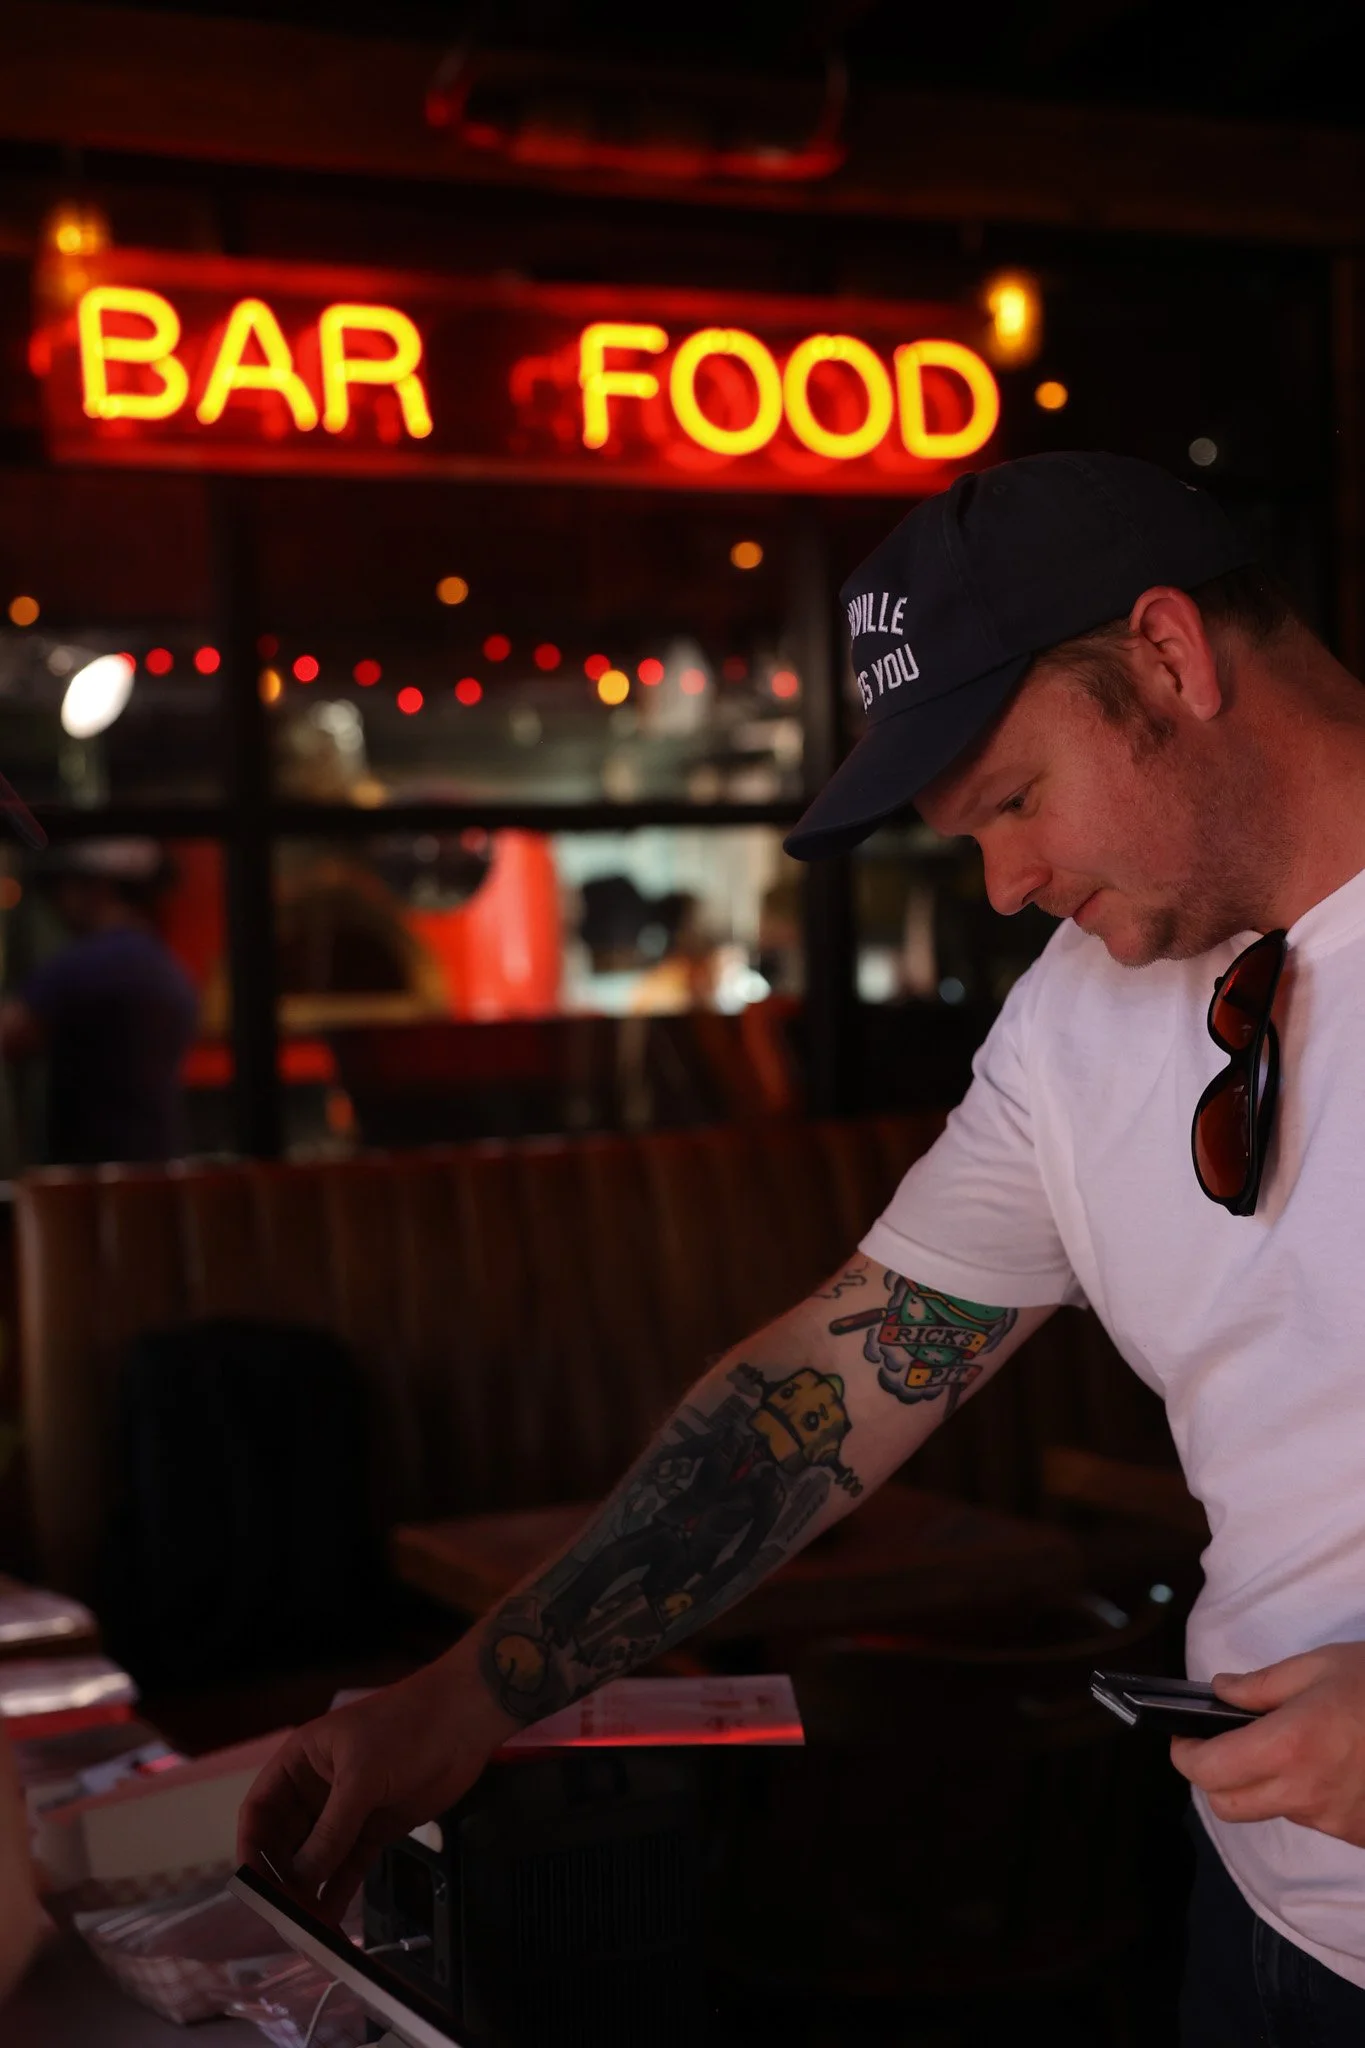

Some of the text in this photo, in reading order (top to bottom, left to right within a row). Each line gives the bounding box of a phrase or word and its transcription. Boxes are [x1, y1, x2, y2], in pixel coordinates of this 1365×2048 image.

[77, 286, 1001, 460] BAR FOOD
[871, 643, 920, 696] YOU
[895, 1327, 975, 1347] RICK'S
